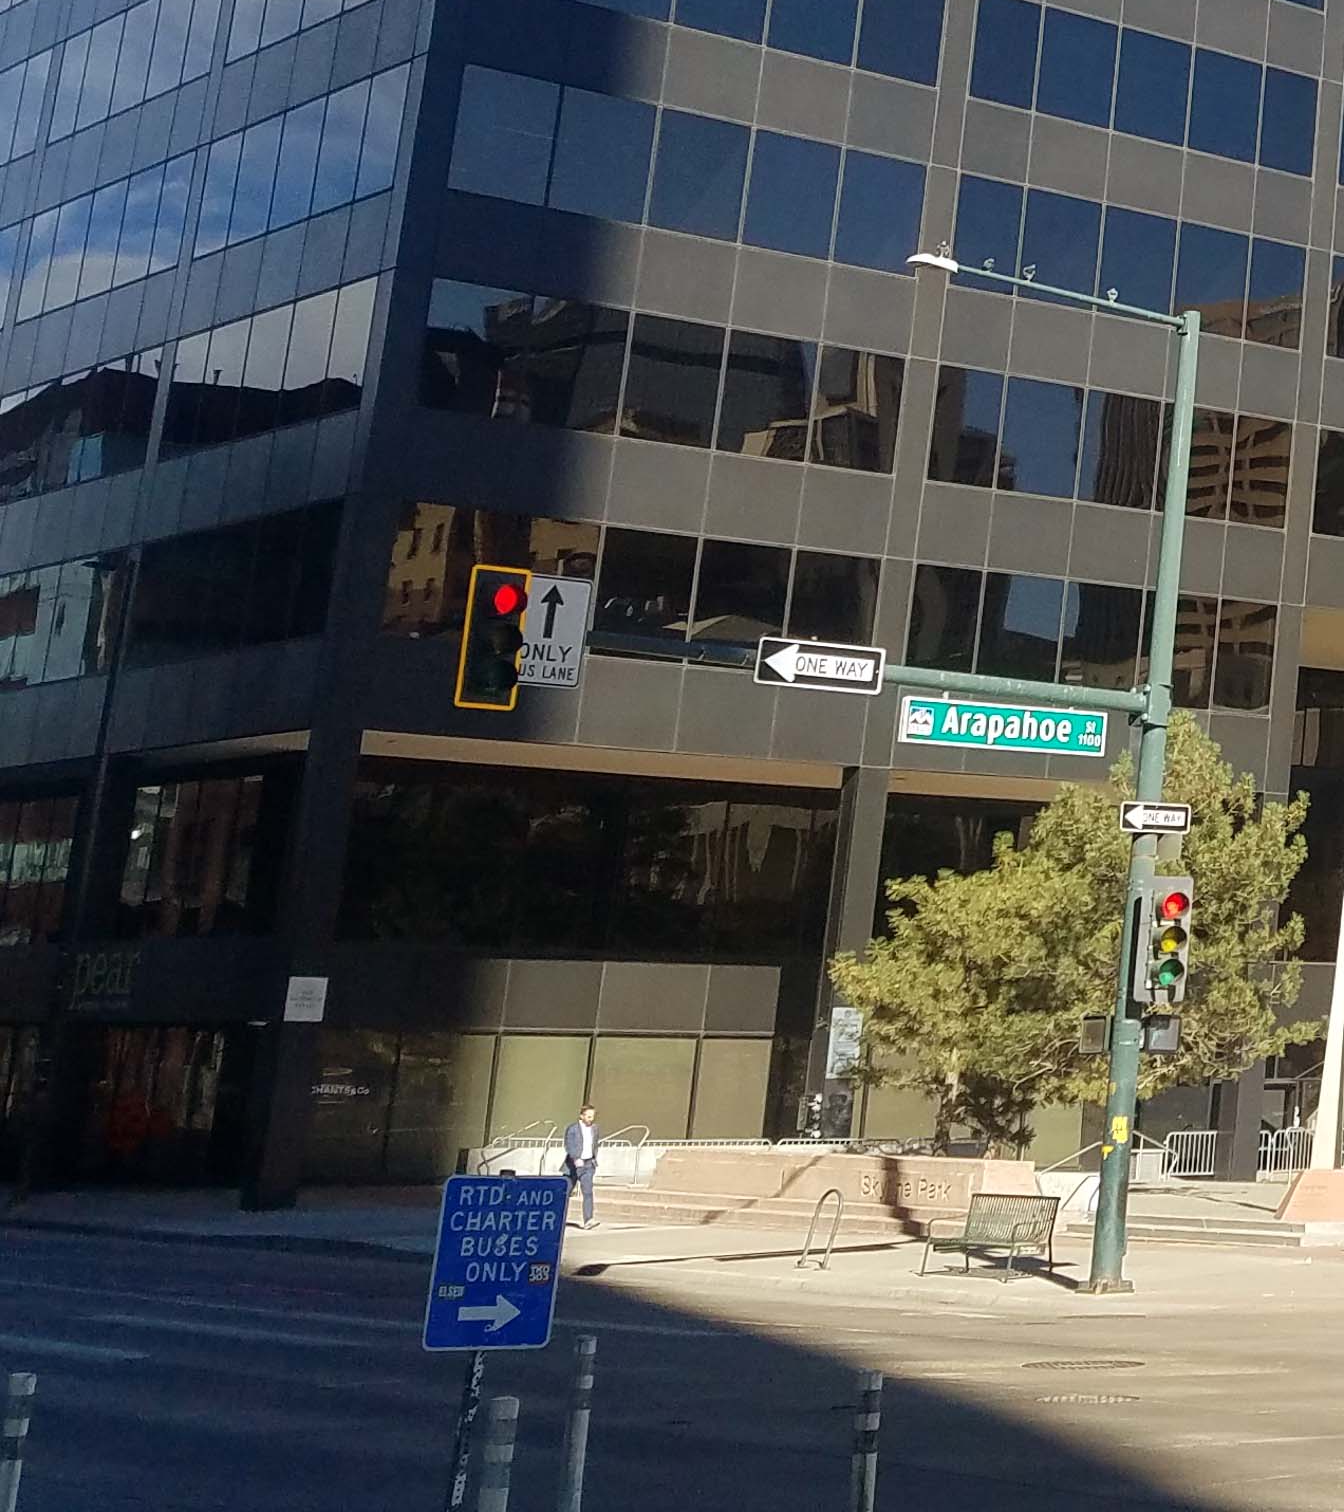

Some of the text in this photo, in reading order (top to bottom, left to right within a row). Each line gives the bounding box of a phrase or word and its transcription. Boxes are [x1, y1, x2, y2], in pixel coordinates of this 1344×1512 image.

[521, 642, 573, 663] ONLY
[518, 662, 576, 681] US LANE
[795, 656, 868, 678] ONE WAY
[941, 706, 1073, 745] Arapahoe
[1078, 733, 1101, 747] 1100
[459, 1185, 553, 1206] RTD AND
[918, 1178, 952, 1201] Park
[450, 1211, 556, 1232] CHARTER
[460, 1236, 539, 1257] BUSES
[465, 1261, 527, 1282] ONLY
